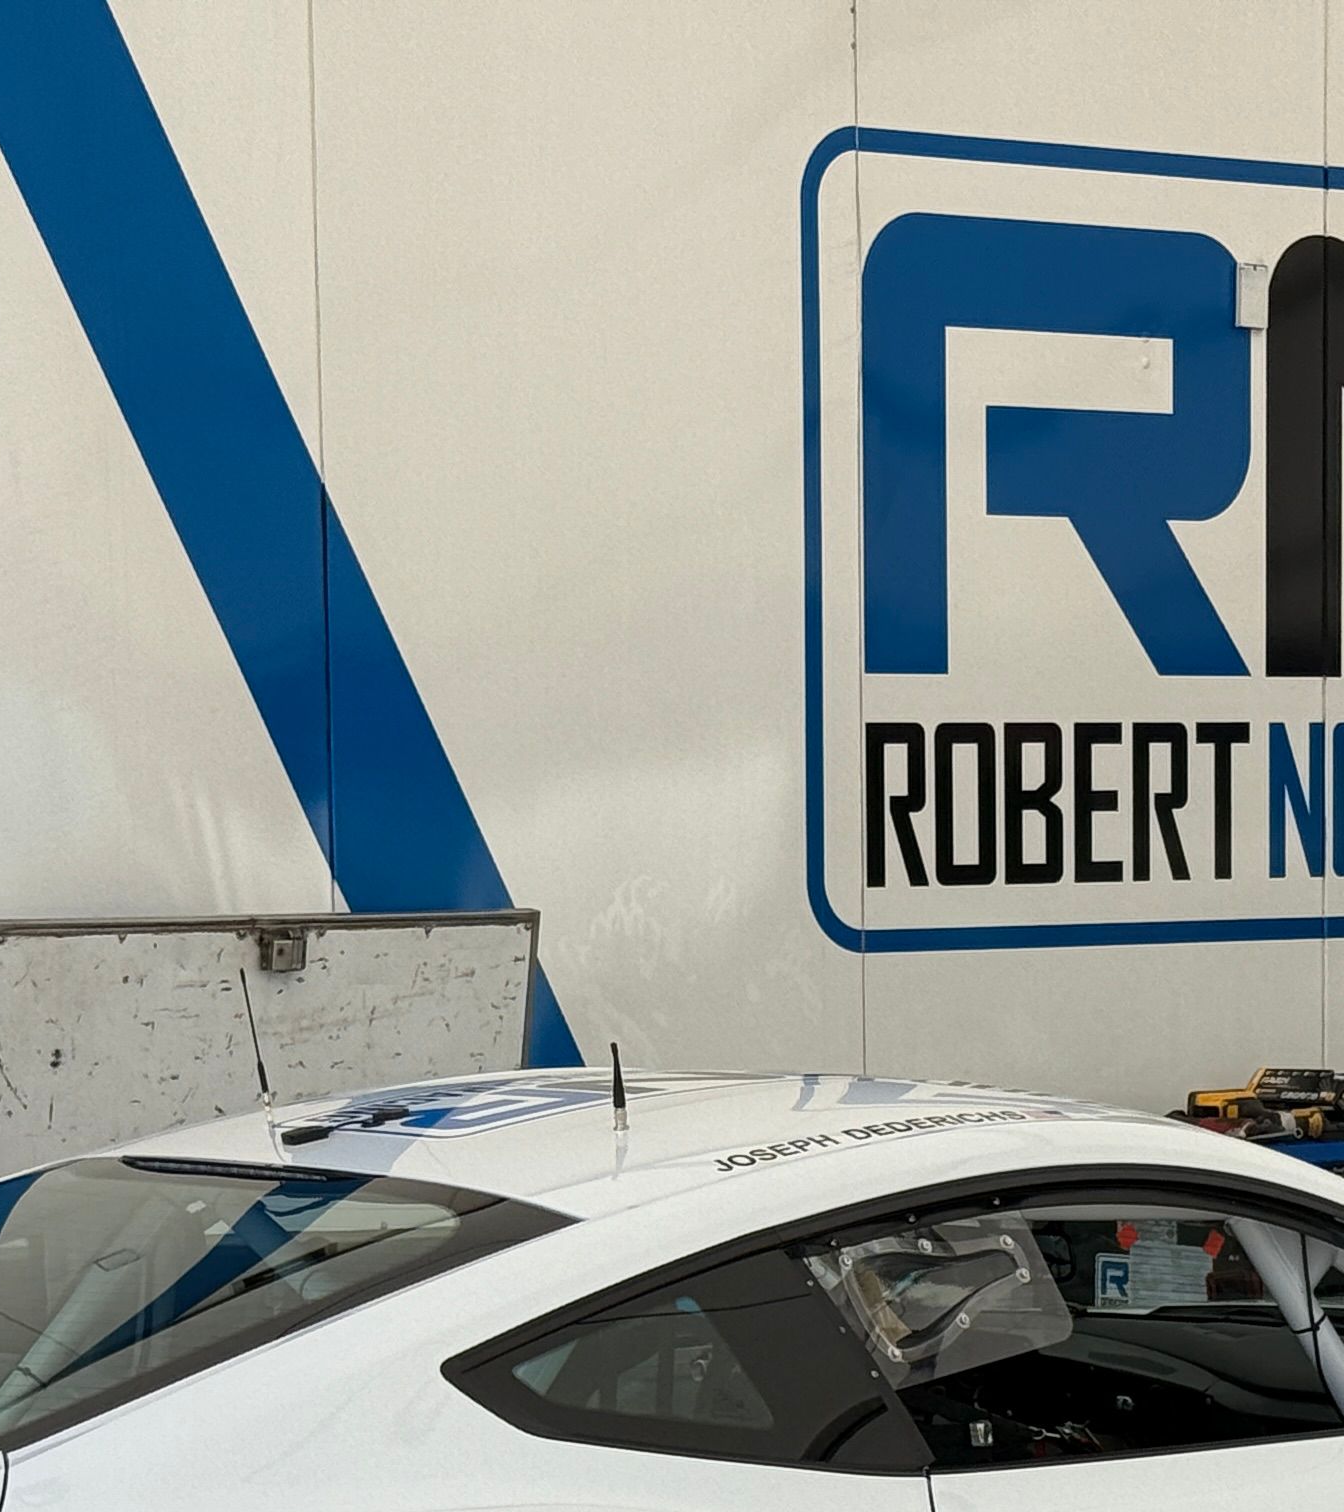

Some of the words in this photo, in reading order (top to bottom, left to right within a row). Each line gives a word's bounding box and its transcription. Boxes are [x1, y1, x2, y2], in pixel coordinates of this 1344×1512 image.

[865, 721, 1250, 888] ROBERT
[713, 1133, 840, 1173] JOSEPH
[842, 1110, 1027, 1141] DEDERICHS
